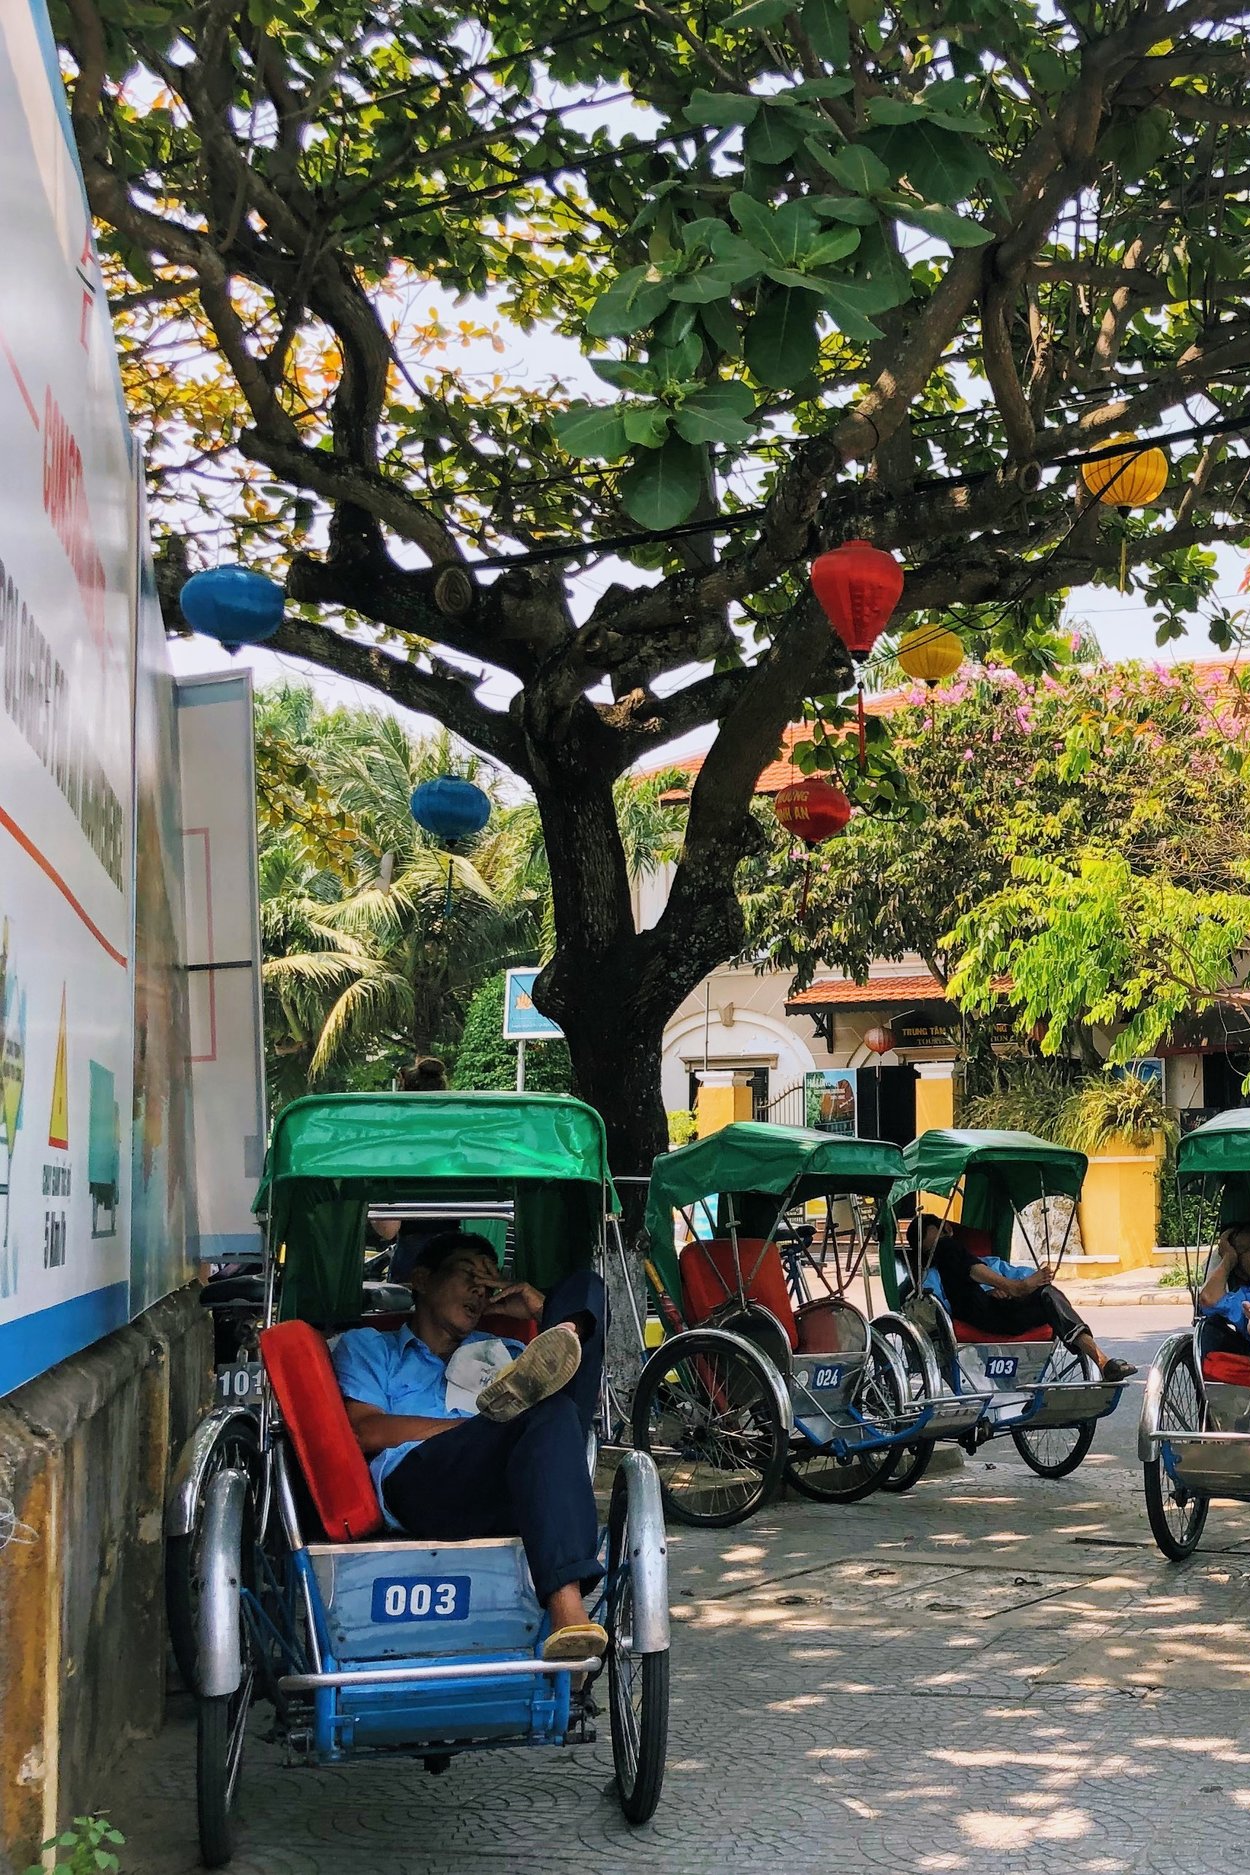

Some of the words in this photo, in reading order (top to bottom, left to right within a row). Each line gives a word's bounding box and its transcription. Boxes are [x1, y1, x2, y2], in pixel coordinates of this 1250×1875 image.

[901, 1027, 929, 1037] TRUNG
[989, 1359, 1015, 1375] 103
[816, 1368, 839, 1387] 024
[385, 1583, 457, 1616] 003
